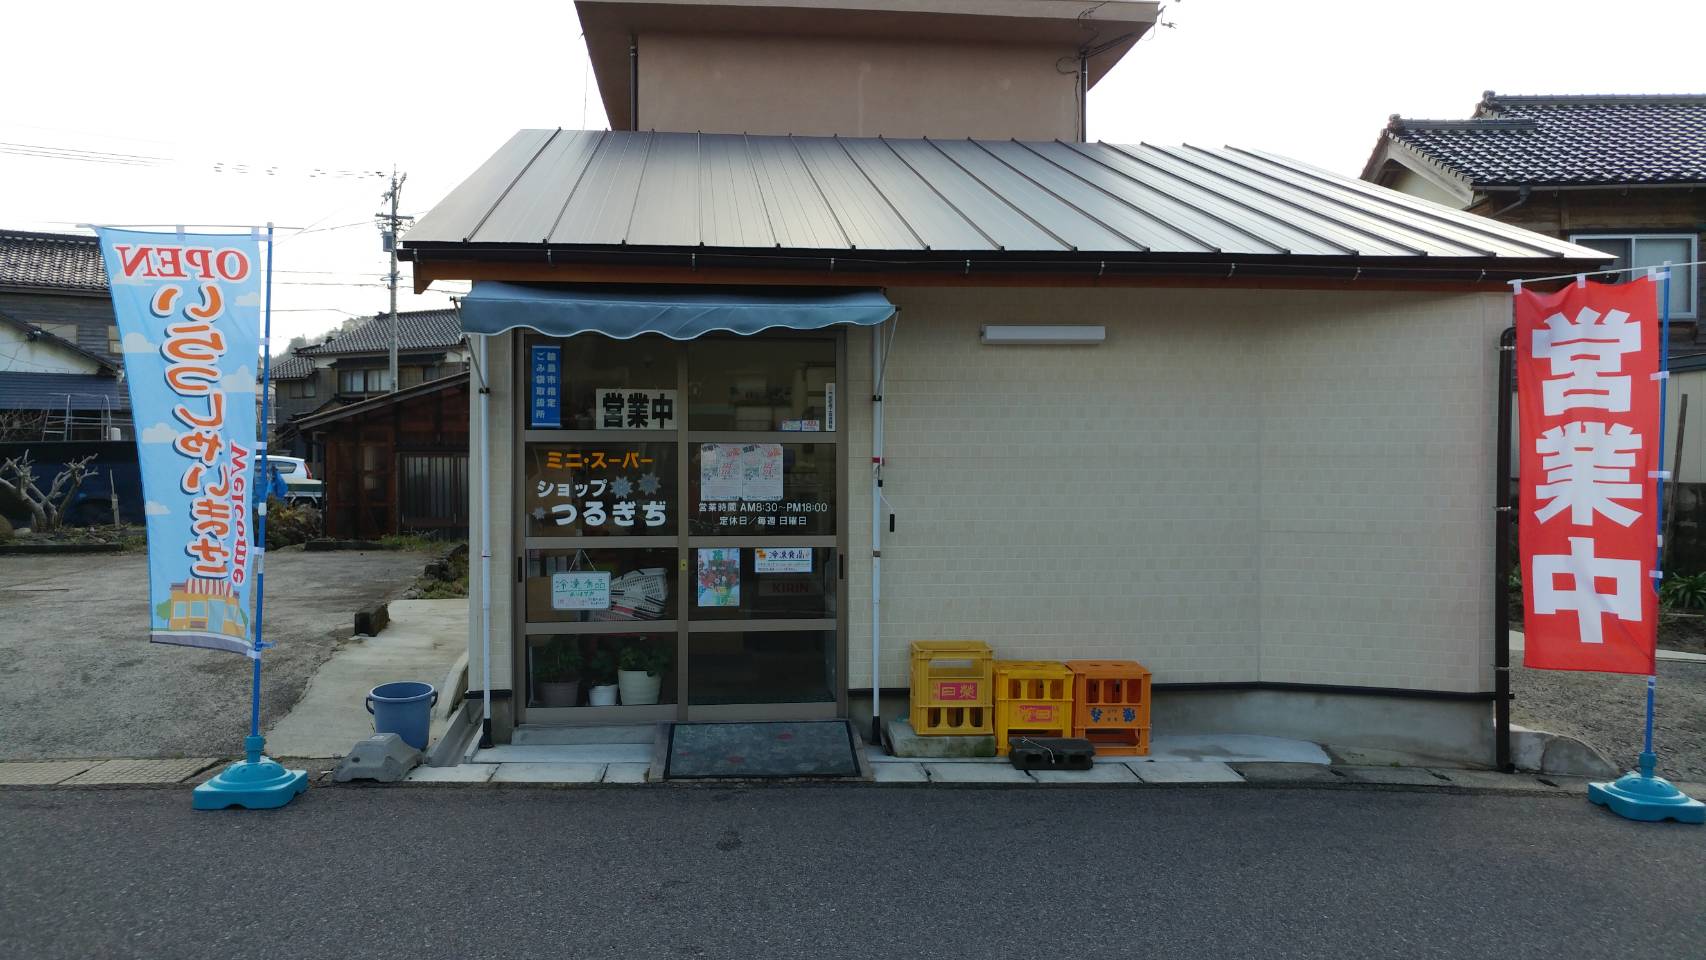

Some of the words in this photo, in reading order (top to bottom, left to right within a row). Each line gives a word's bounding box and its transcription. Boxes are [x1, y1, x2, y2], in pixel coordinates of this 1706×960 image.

[602, 392, 673, 428] 営業中
[1531, 306, 1642, 644] 営業中
[536, 478, 608, 498] ショップ
[551, 500, 667, 527] つるぎぢ
[698, 502, 737, 512] 営業時間
[779, 516, 808, 526] 日曜日
[772, 583, 809, 593] KIRIN
